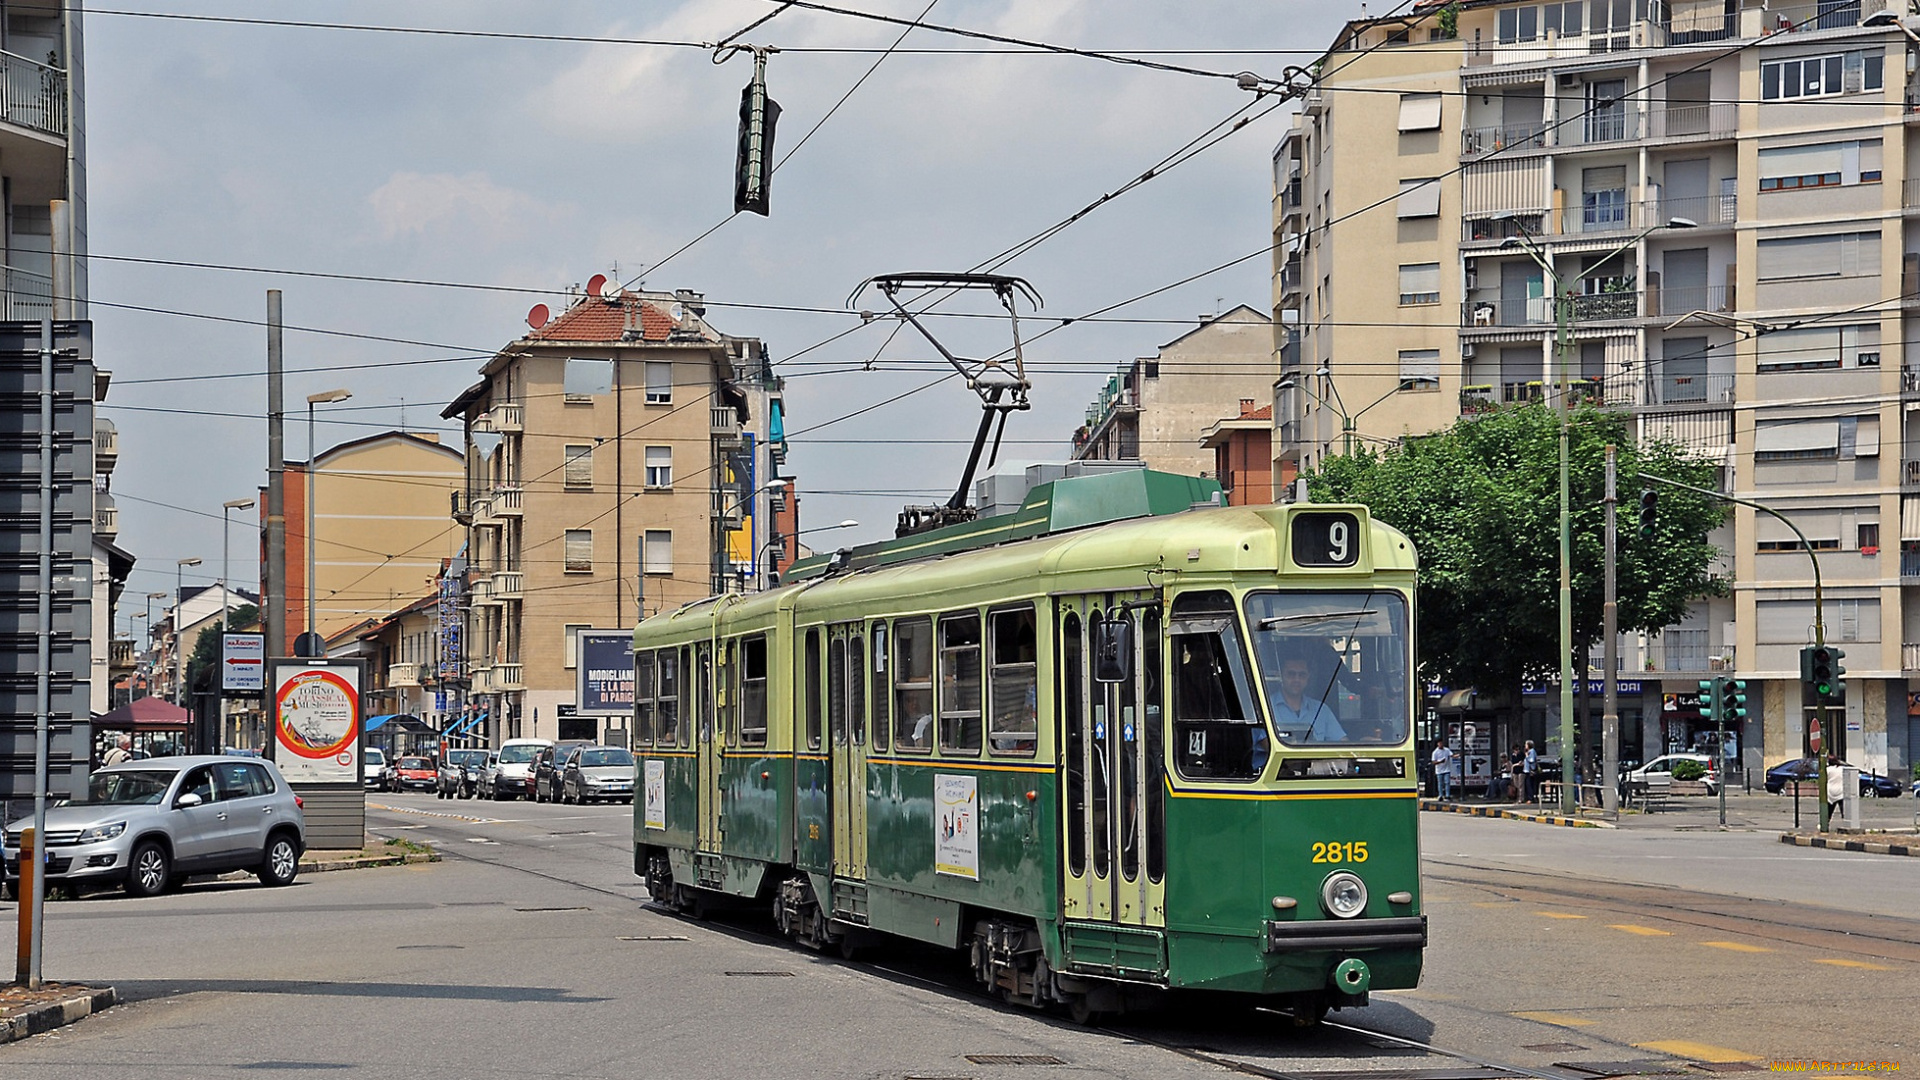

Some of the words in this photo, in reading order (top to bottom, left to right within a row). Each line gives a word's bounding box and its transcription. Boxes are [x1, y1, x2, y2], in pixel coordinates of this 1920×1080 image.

[1328, 520, 1349, 562] 9
[299, 687, 334, 695] TORINO
[600, 681, 607, 692] E
[608, 681, 618, 692] LA
[298, 694, 347, 702] CLASSICAL
[600, 692, 608, 703] DI
[1191, 731, 1204, 752] 21
[1311, 841, 1369, 863] 2815
